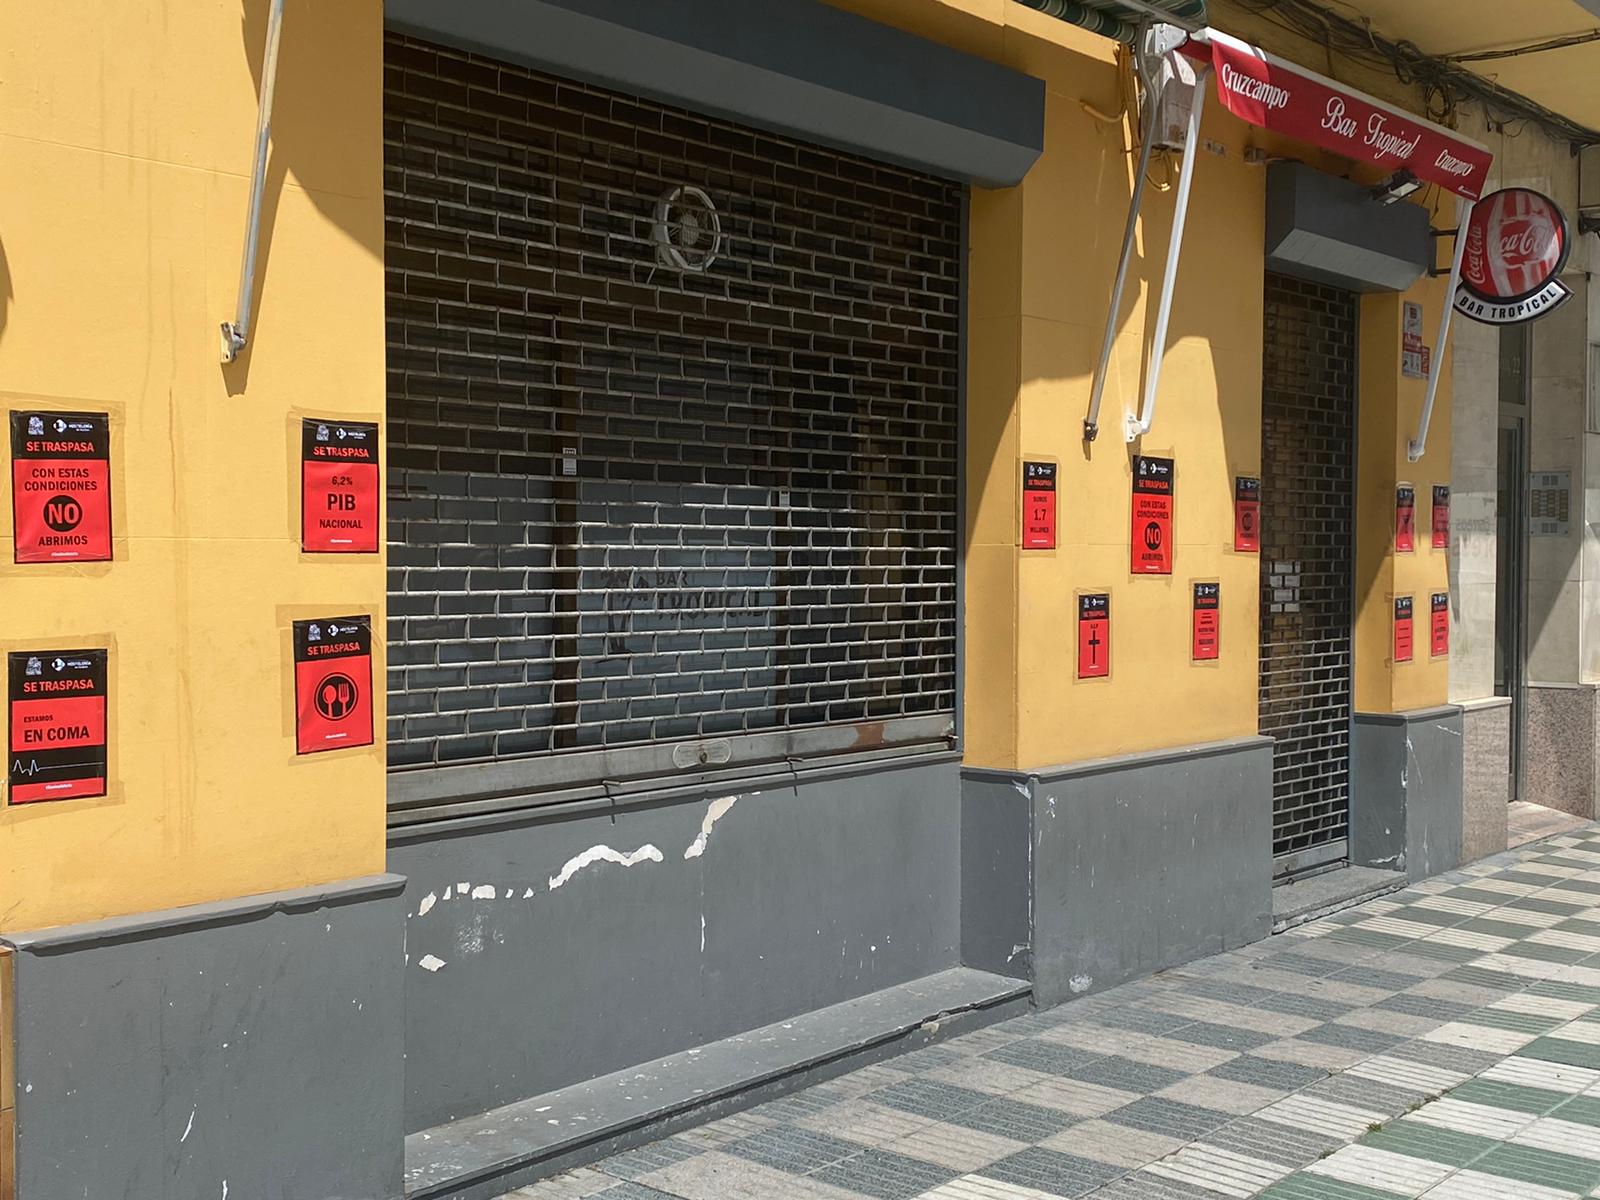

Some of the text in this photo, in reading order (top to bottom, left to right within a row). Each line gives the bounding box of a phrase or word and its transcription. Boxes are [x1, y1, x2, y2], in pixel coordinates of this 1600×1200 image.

[1222, 63, 1289, 110] Cruzcampo
[1321, 96, 1422, 160] Bar Tropical
[1459, 289, 1557, 319] BAR TROPICAL
[26, 441, 95, 453] SE TRASPASA
[313, 446, 369, 458] SE TRASPASA
[32, 468, 89, 478] CON ESTAS
[24, 481, 98, 491] CONDICIONES
[327, 494, 356, 511] PIB
[48, 503, 79, 525] NO
[319, 519, 363, 529] NACIONAL
[38, 535, 88, 547] ABRIMOS
[1146, 527, 1161, 544] NO
[656, 570, 689, 586] BAR
[307, 642, 361, 656] SE TRASPASA
[23, 679, 95, 693] SE TRASPASA
[23, 715, 54, 723] ESTAMOS
[24, 725, 90, 743] EN COMA
